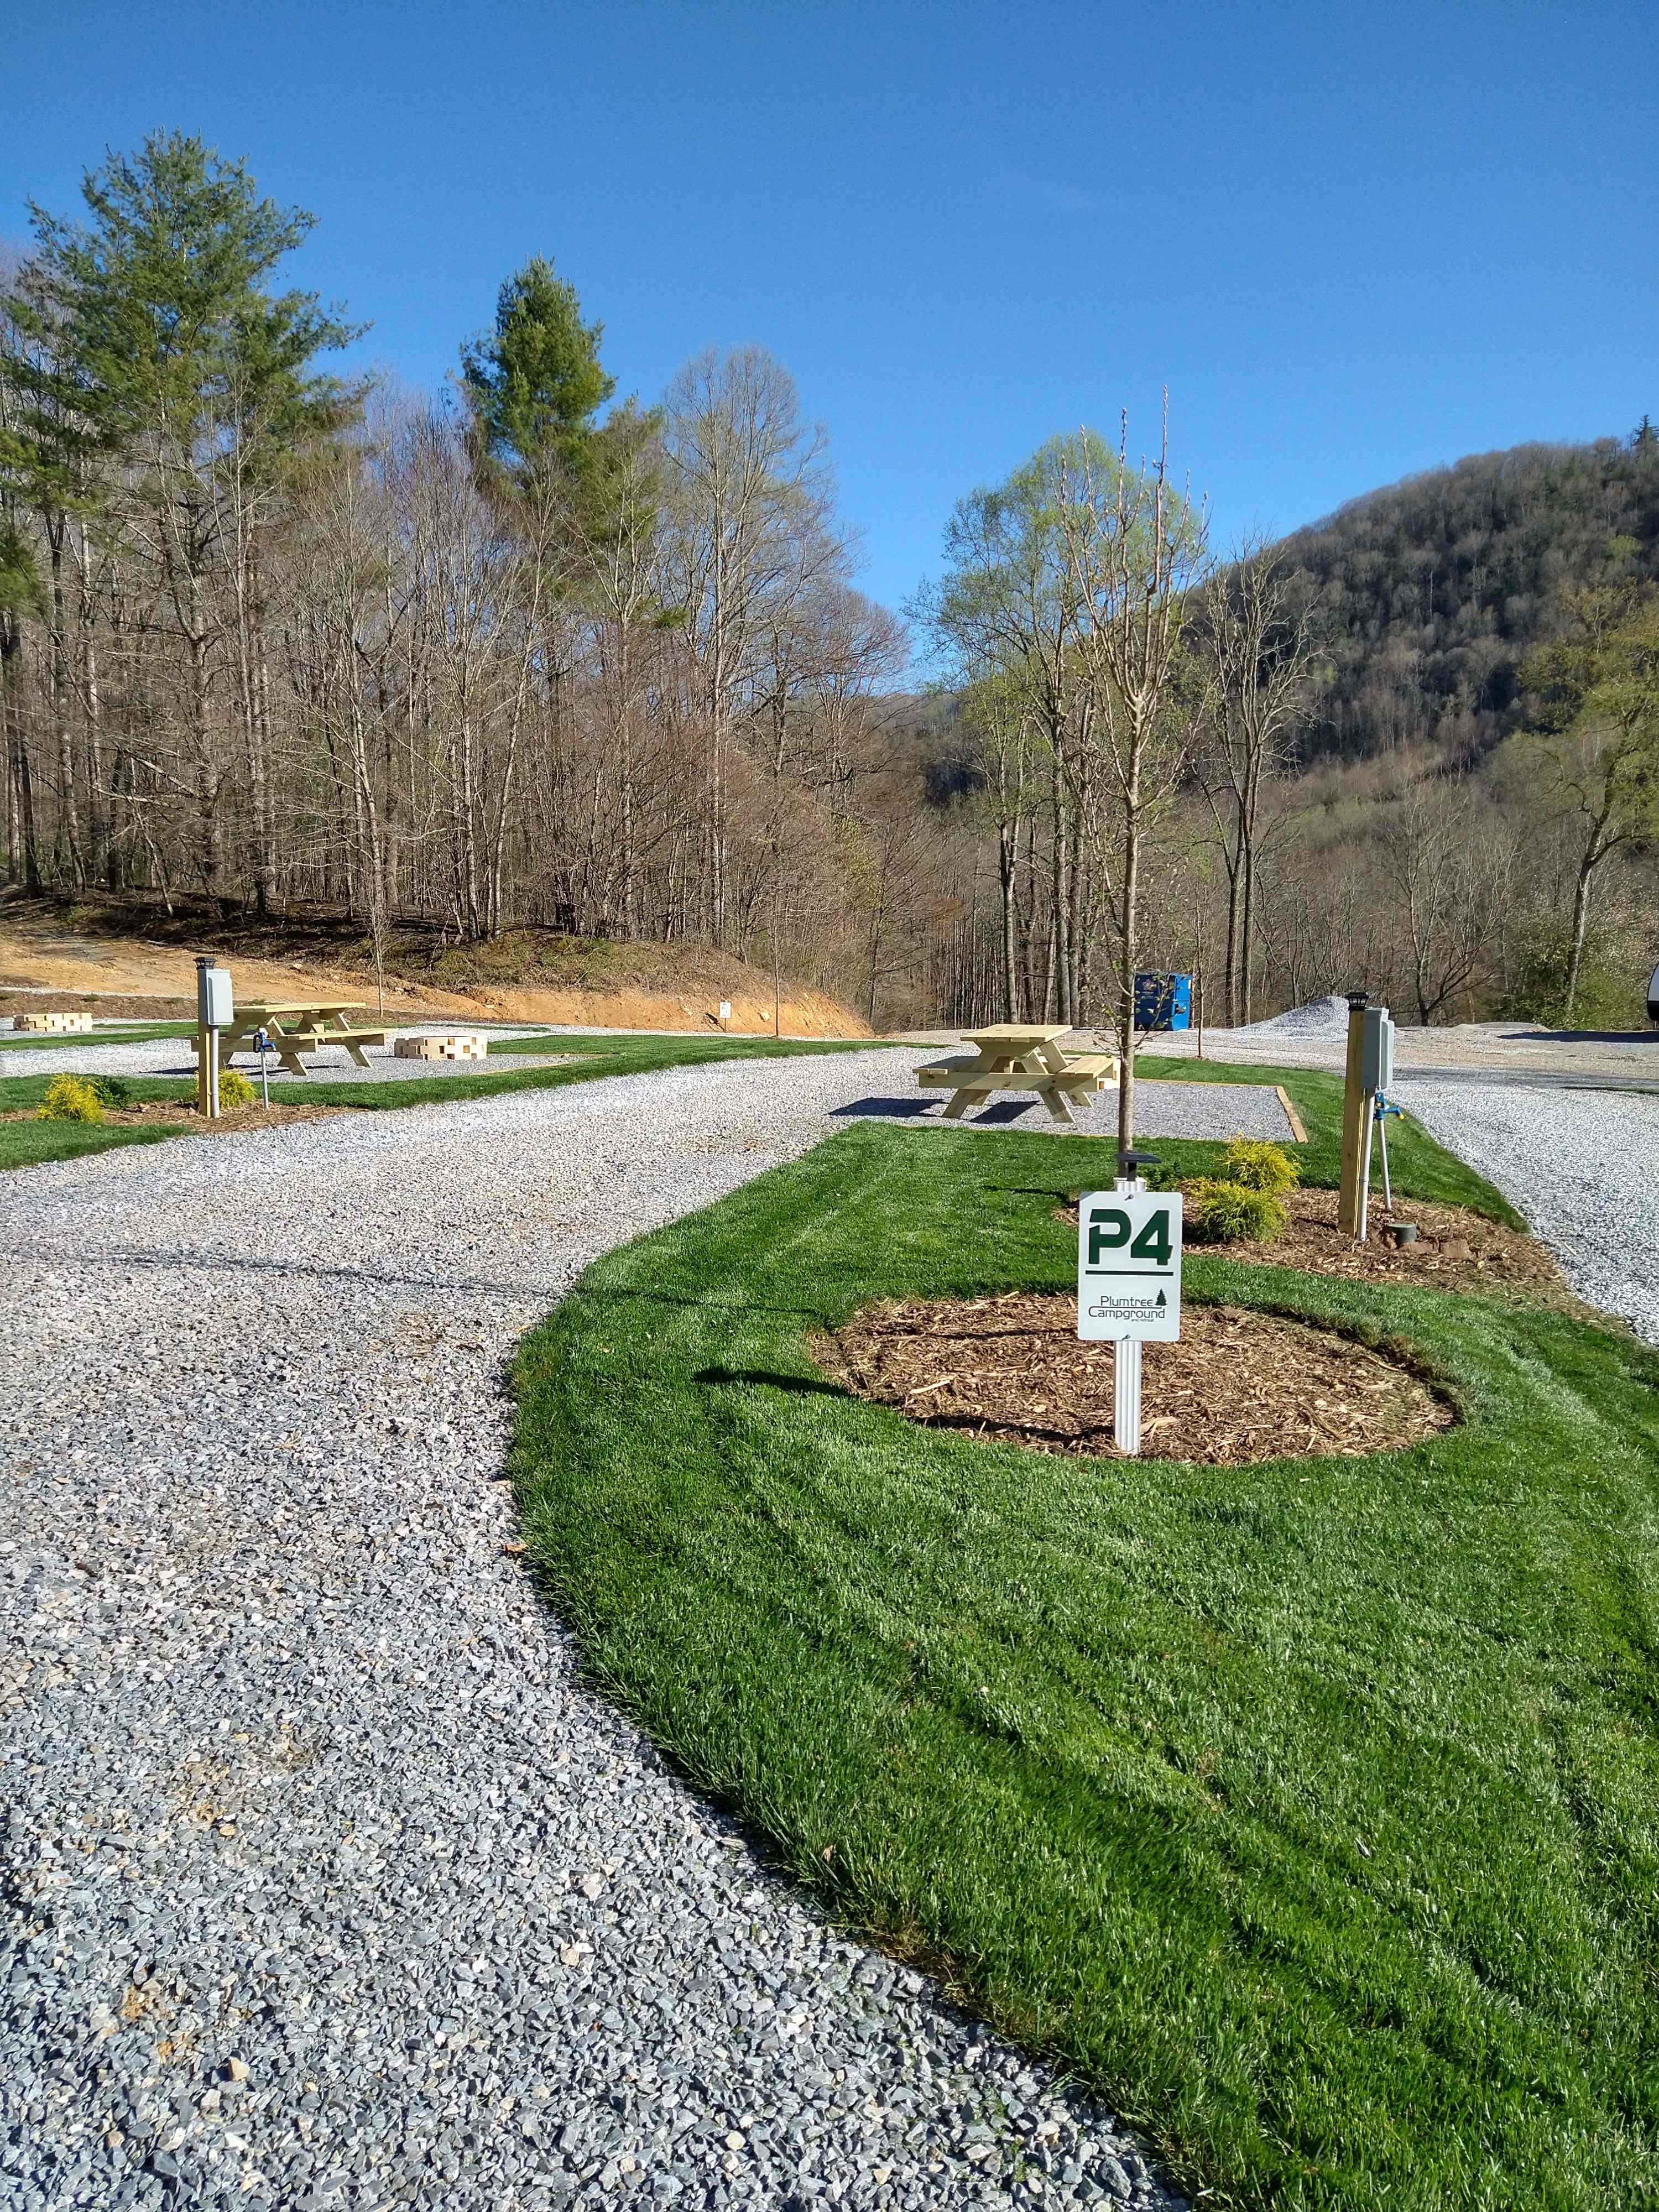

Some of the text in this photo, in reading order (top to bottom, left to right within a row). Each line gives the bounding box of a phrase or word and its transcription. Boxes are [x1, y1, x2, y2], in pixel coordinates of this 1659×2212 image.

[1088, 1209, 1173, 1266] P4
[1100, 1296, 1154, 1307] Plumtree
[1088, 1306, 1165, 1319] Campground
